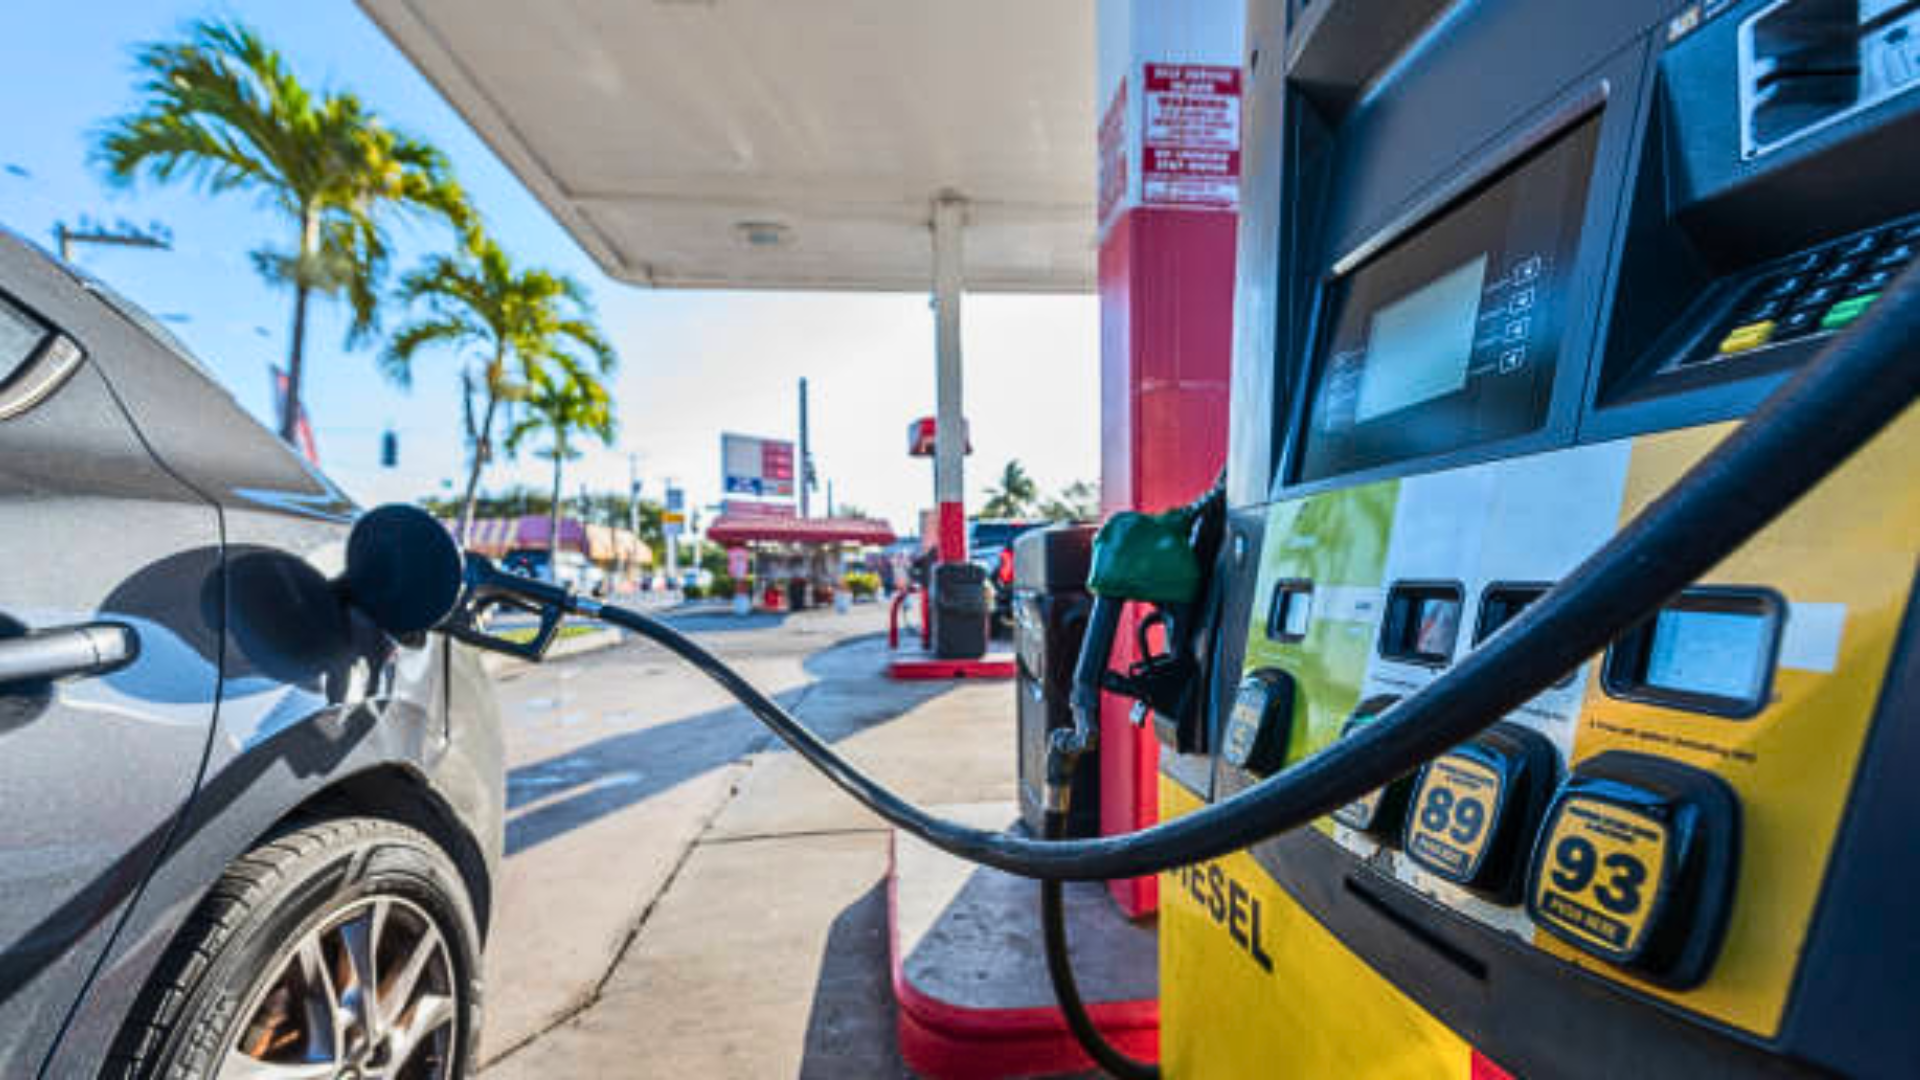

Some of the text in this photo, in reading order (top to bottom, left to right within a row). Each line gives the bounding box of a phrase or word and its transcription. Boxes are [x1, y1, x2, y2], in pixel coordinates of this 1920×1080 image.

[1422, 787, 1484, 844] 89
[1552, 835, 1646, 915] 93
[1167, 862, 1273, 975] IESEL
